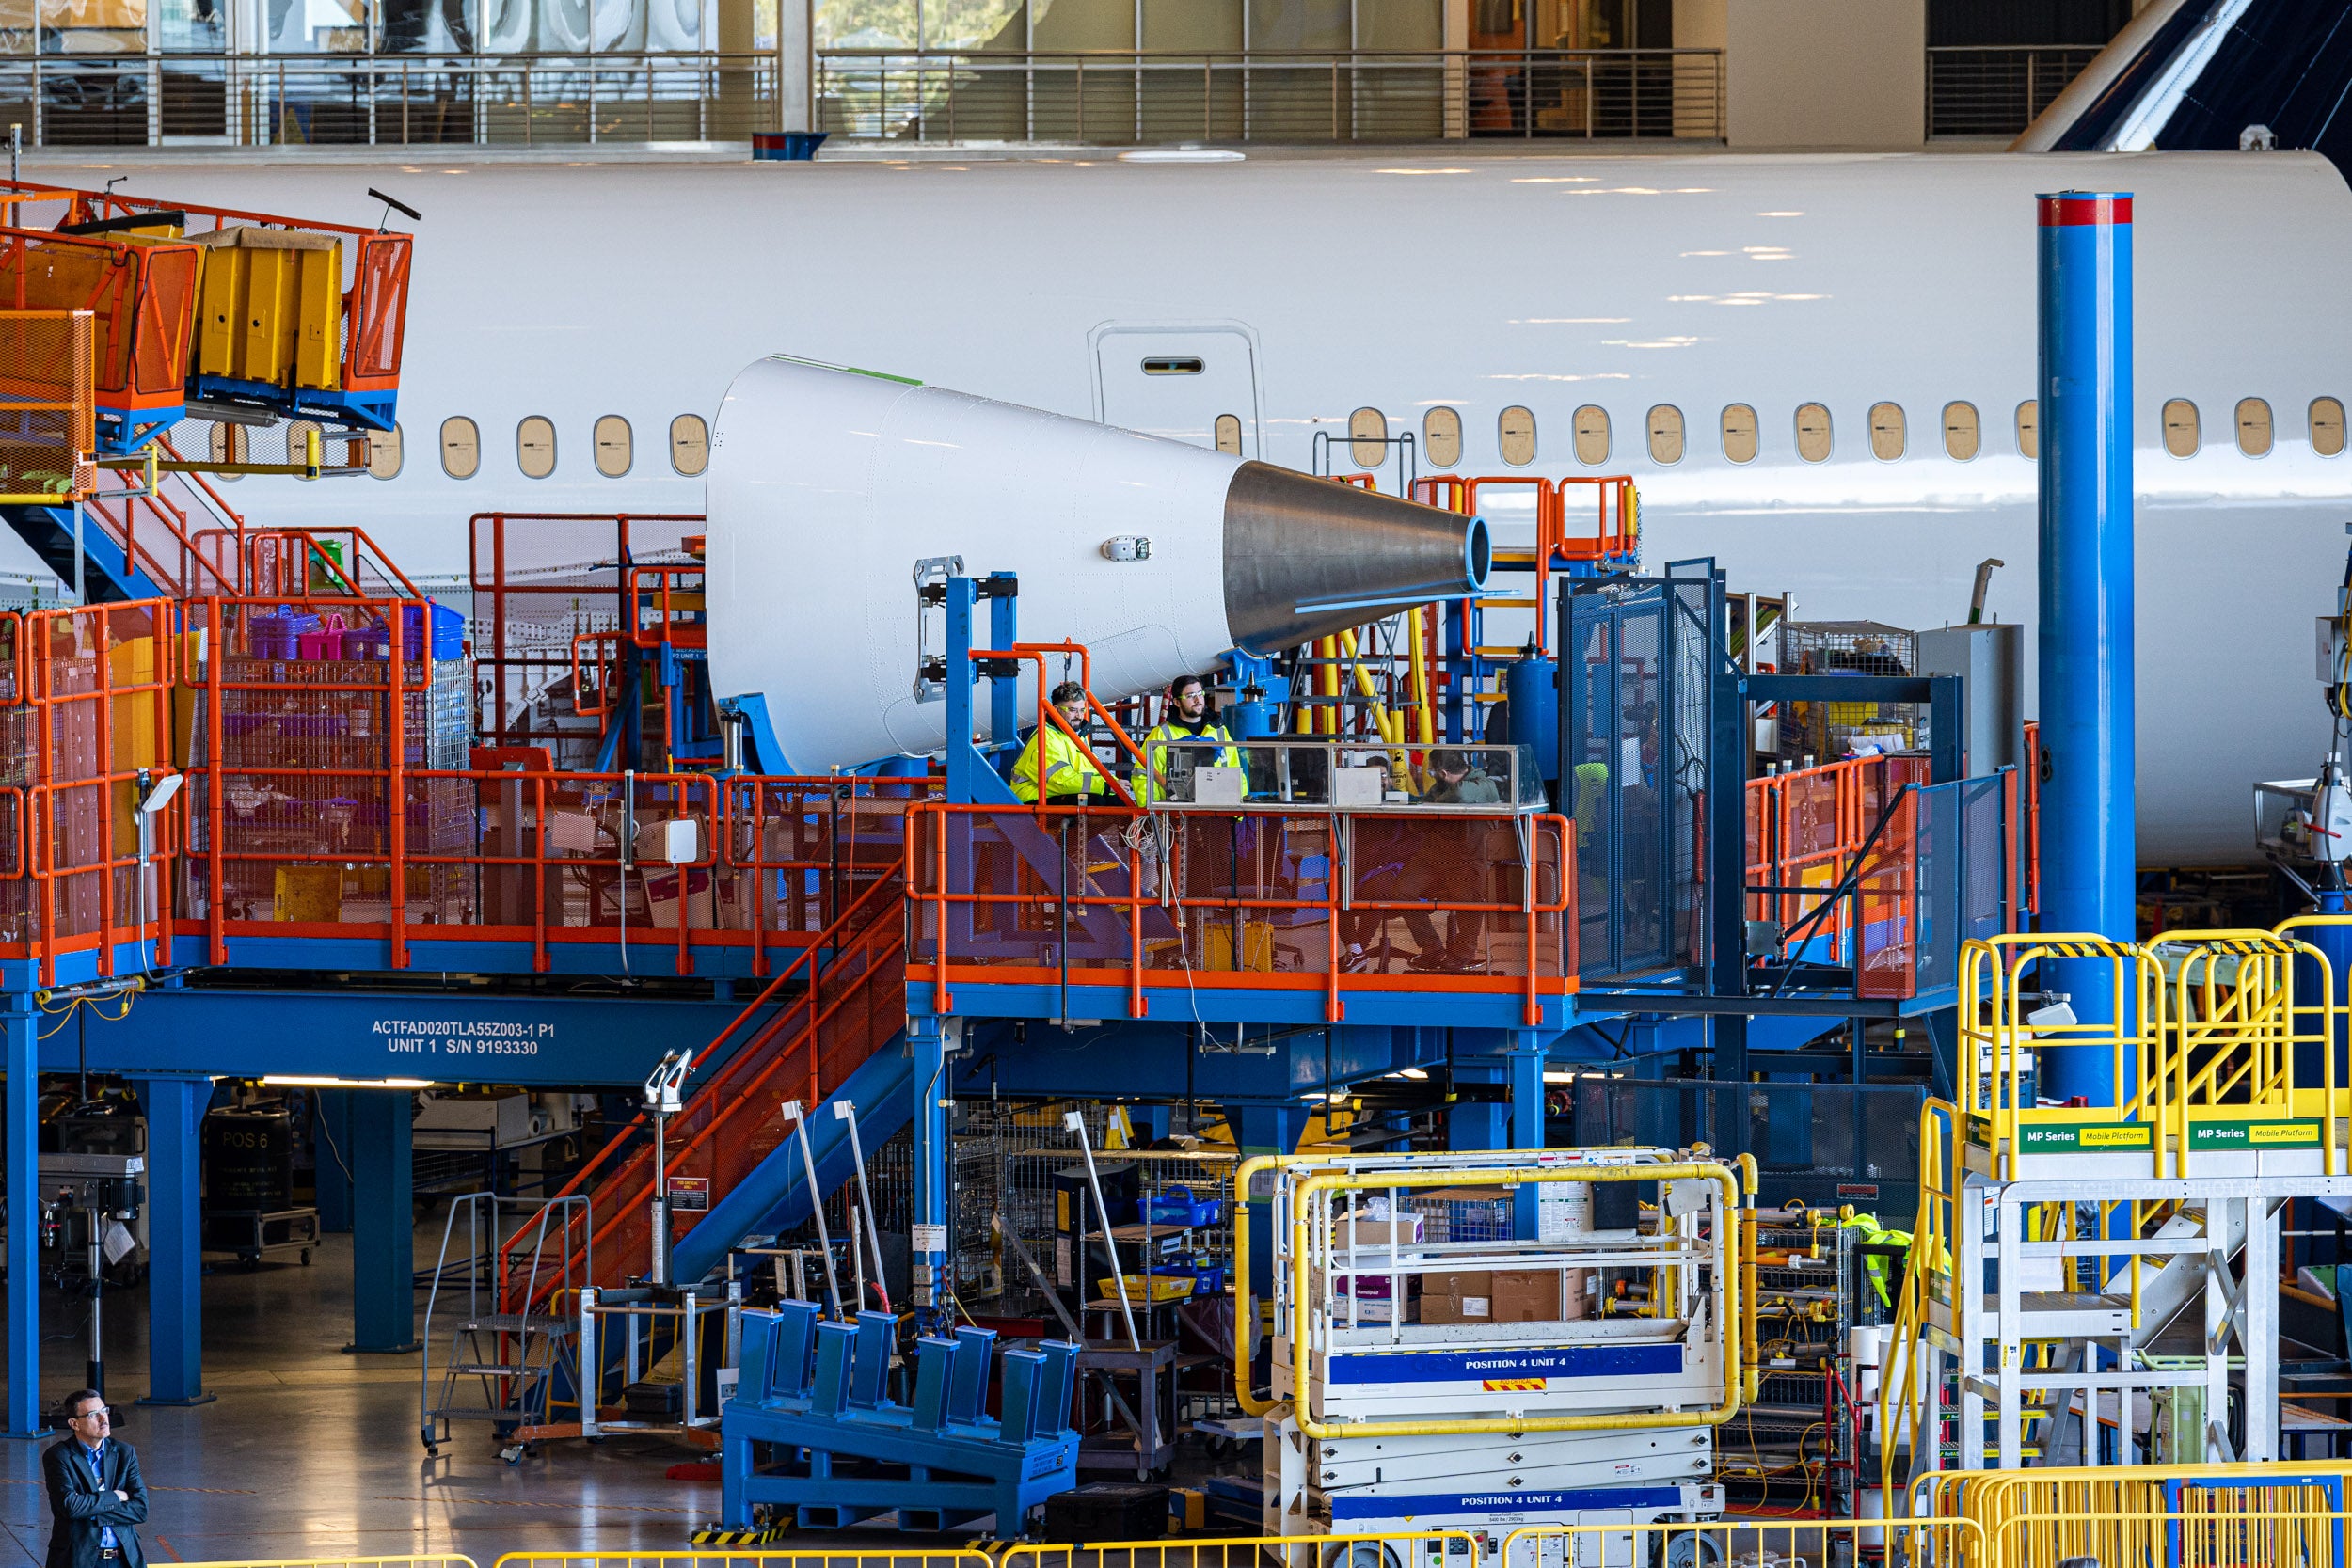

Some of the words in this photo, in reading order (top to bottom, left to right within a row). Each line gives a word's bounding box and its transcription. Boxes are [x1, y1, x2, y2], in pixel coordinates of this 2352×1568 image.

[373, 1021, 534, 1037] ACTFAD020TLA55Z003-1
[539, 1024, 554, 1037] P1
[388, 1038, 424, 1052] UNIT
[429, 1039, 436, 1053] 1
[446, 1039, 471, 1053] S/N
[477, 1040, 538, 1054] 9193330
[2028, 1132, 2043, 1141] MP
[2045, 1132, 2075, 1141] Series
[2112, 1132, 2143, 1141] Platform
[2197, 1129, 2213, 1138] MP
[2215, 1129, 2245, 1138] Series
[2281, 1129, 2313, 1138] Platform
[223, 1132, 255, 1148] POS
[260, 1133, 268, 1148] 6
[1466, 1360, 1516, 1369] POSITION
[1531, 1358, 1556, 1366] UNIT
[1462, 1497, 1512, 1505] POSITION
[1527, 1495, 1552, 1504] UNIT
